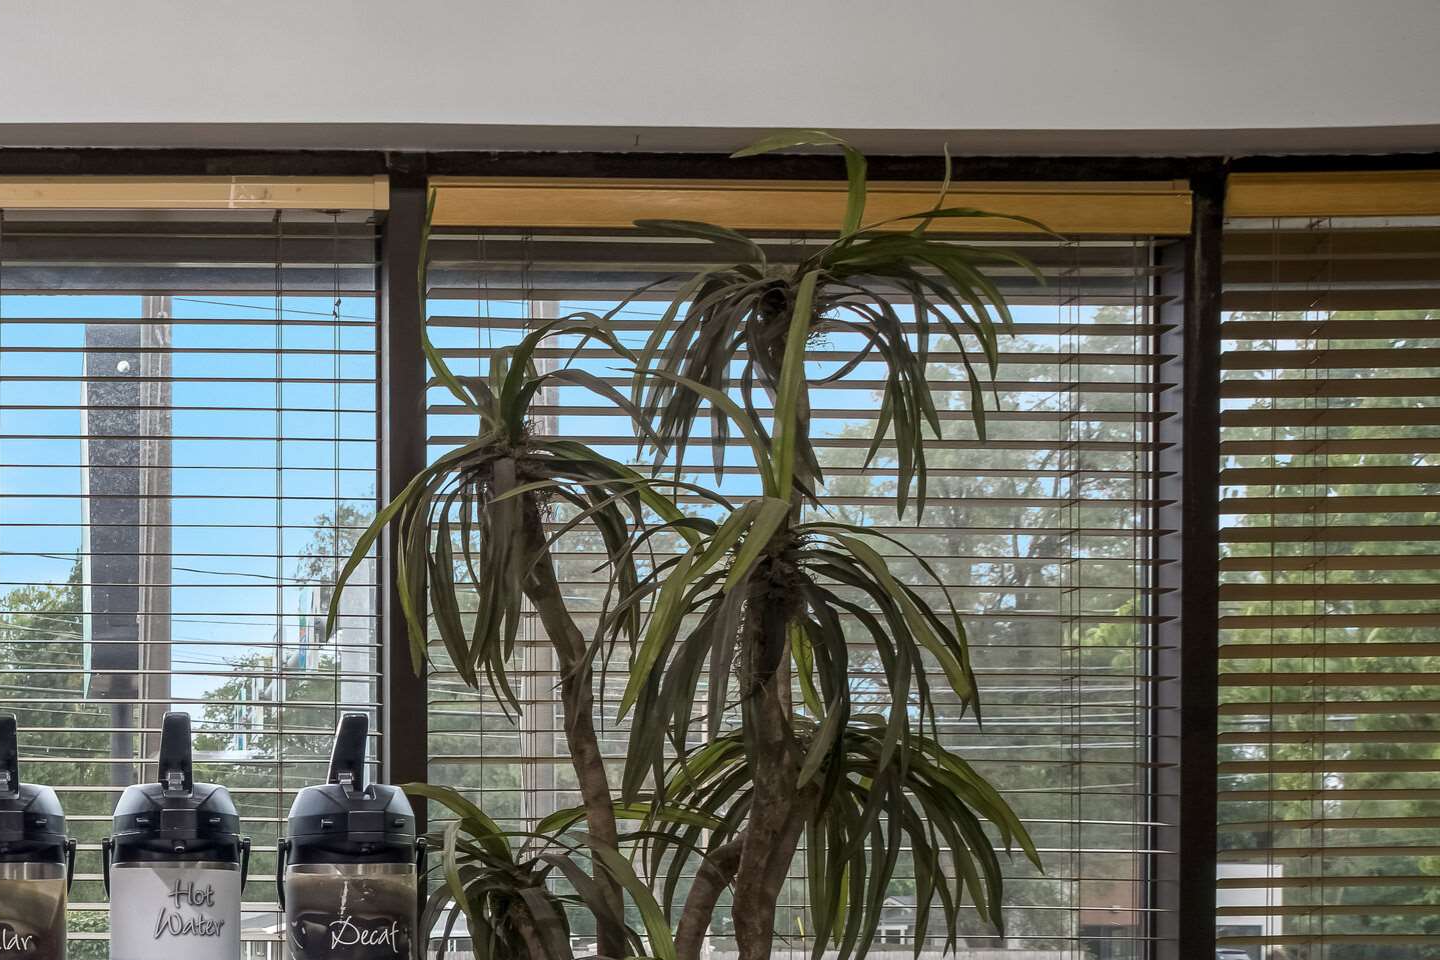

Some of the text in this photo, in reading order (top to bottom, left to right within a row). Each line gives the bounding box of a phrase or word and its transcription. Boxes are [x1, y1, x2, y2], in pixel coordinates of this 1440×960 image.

[168, 879, 215, 909] Hot
[154, 906, 225, 940] Water
[329, 915, 399, 953] Decaf
